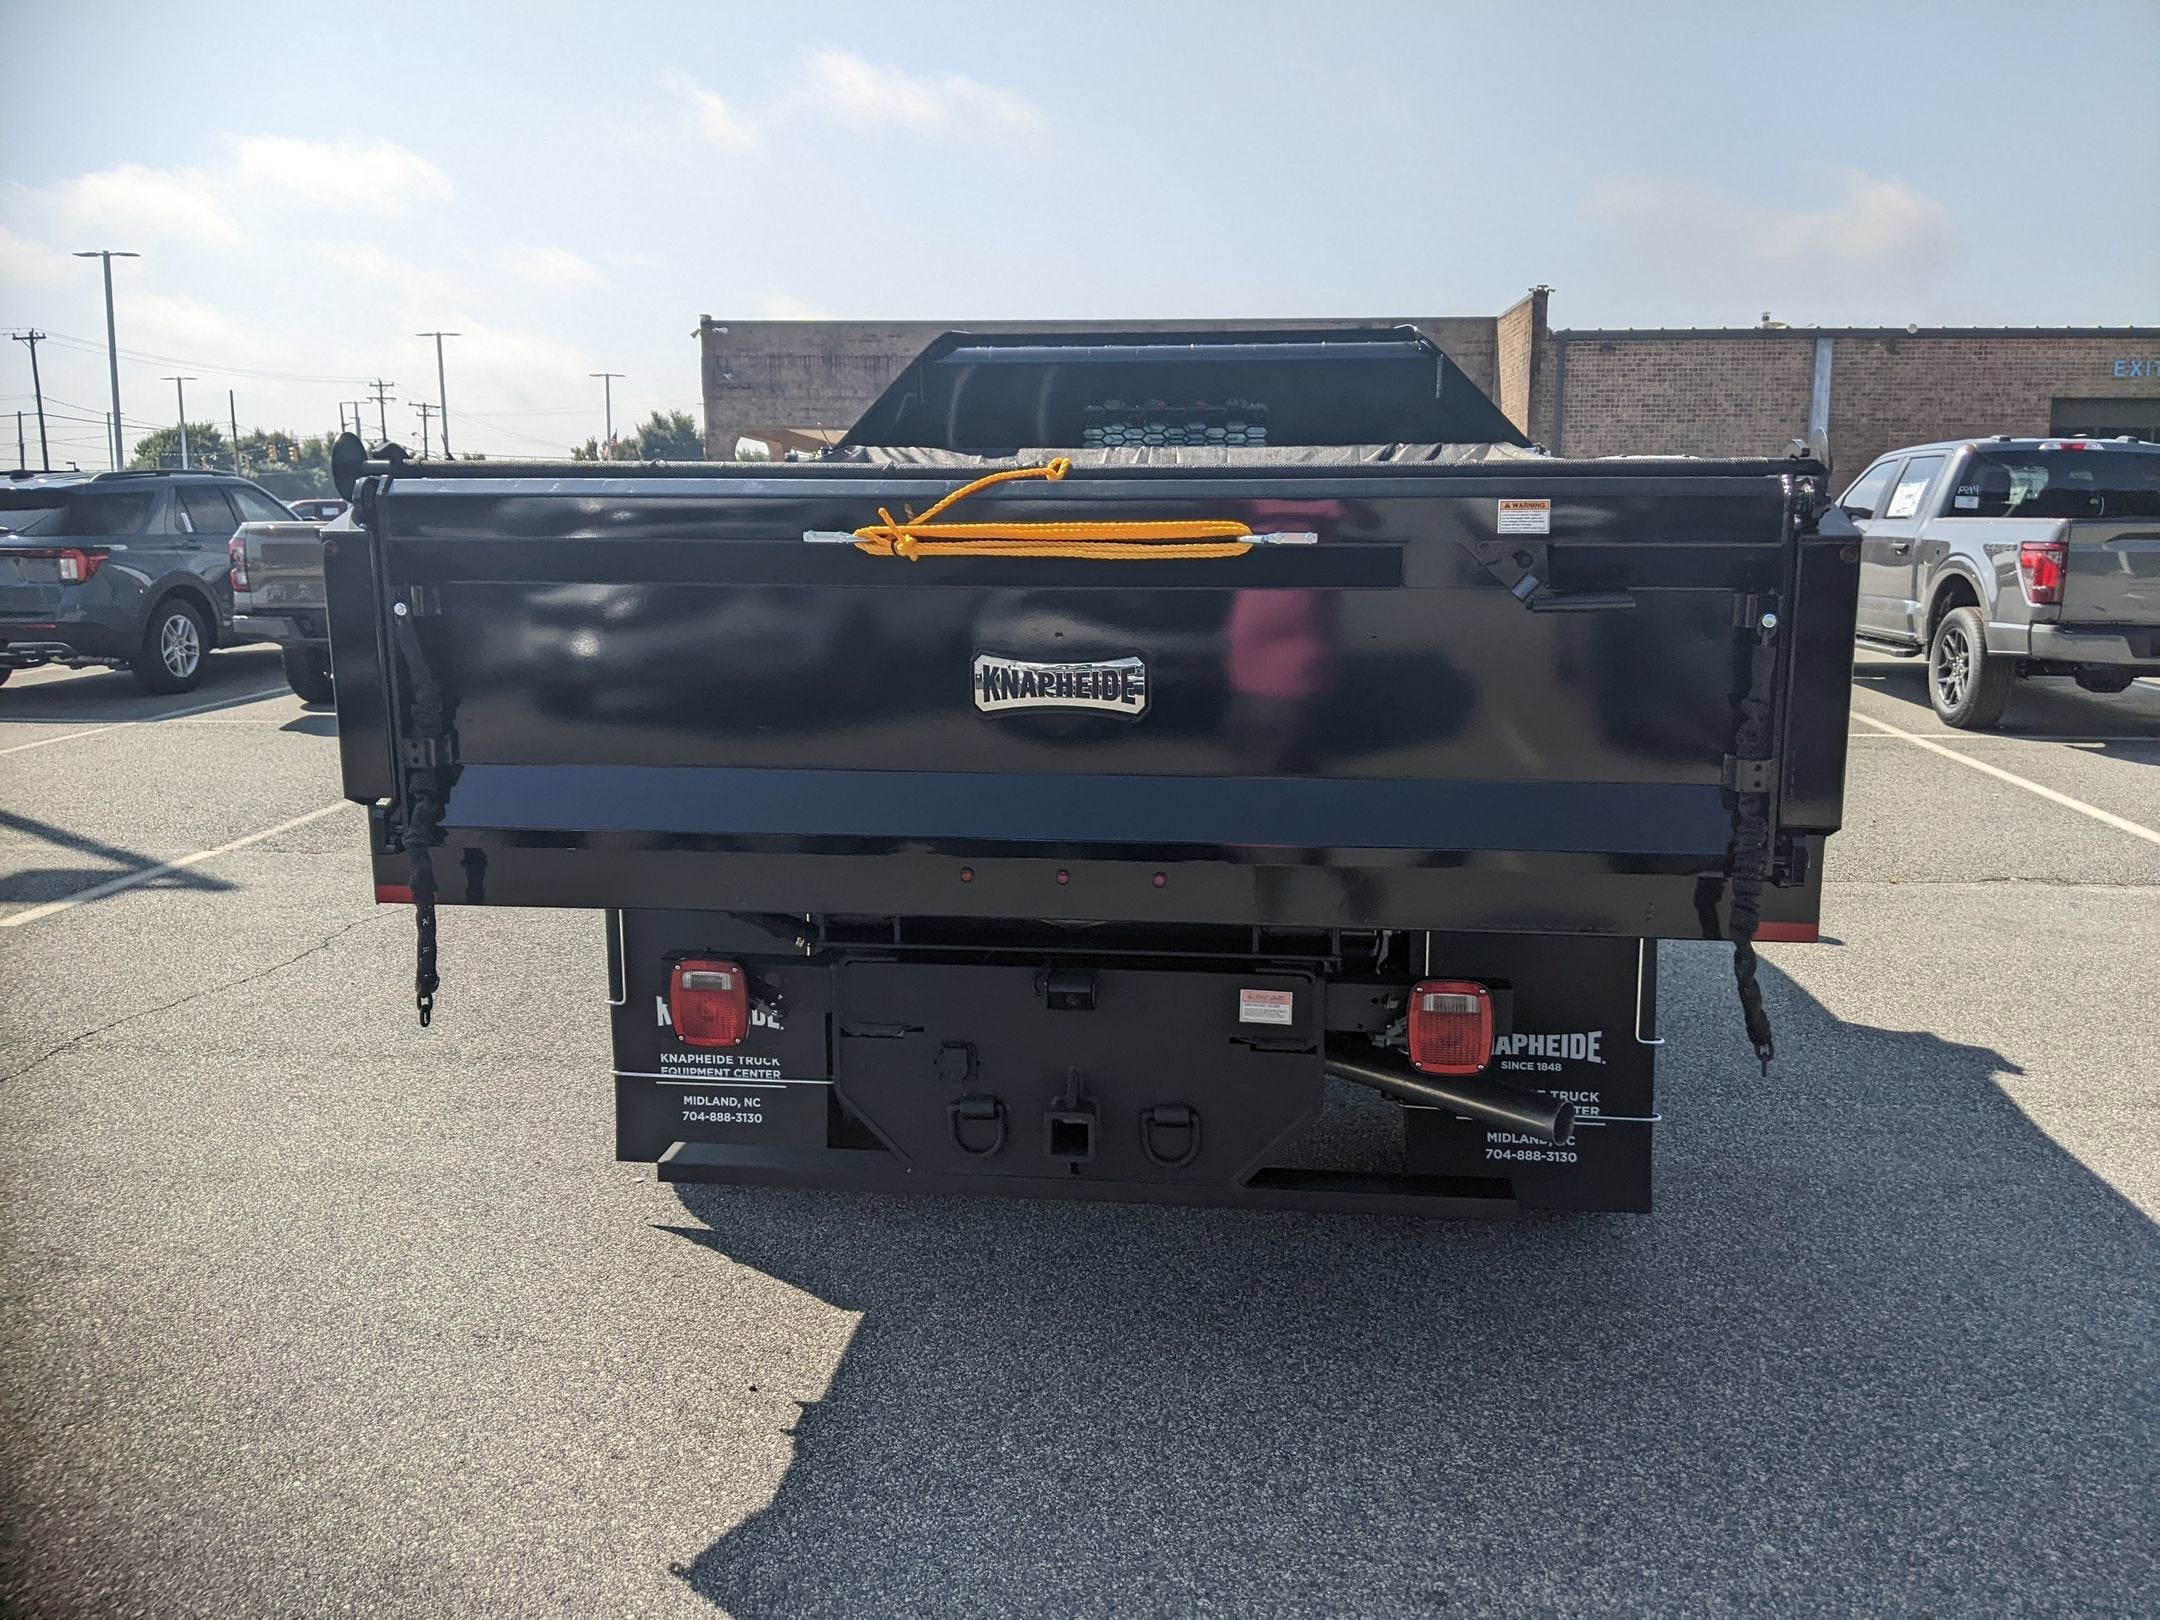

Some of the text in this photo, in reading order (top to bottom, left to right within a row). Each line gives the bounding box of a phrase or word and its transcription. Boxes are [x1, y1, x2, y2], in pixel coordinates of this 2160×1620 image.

[982, 664, 1137, 704] KNAPHEIDE
[660, 1053, 780, 1066] KNAPHEIDE TRUCK
[660, 1066, 781, 1079] EQUIPMENT CENTER
[1501, 1061, 1562, 1072] SINCE 1848
[683, 1095, 761, 1108] MIDLAND, NC
[1550, 1090, 1600, 1102] TRUCK
[682, 1111, 762, 1123] 704-888-3130
[1573, 1105, 1600, 1116] TER
[1485, 1149, 1577, 1162] 704-888-3130
